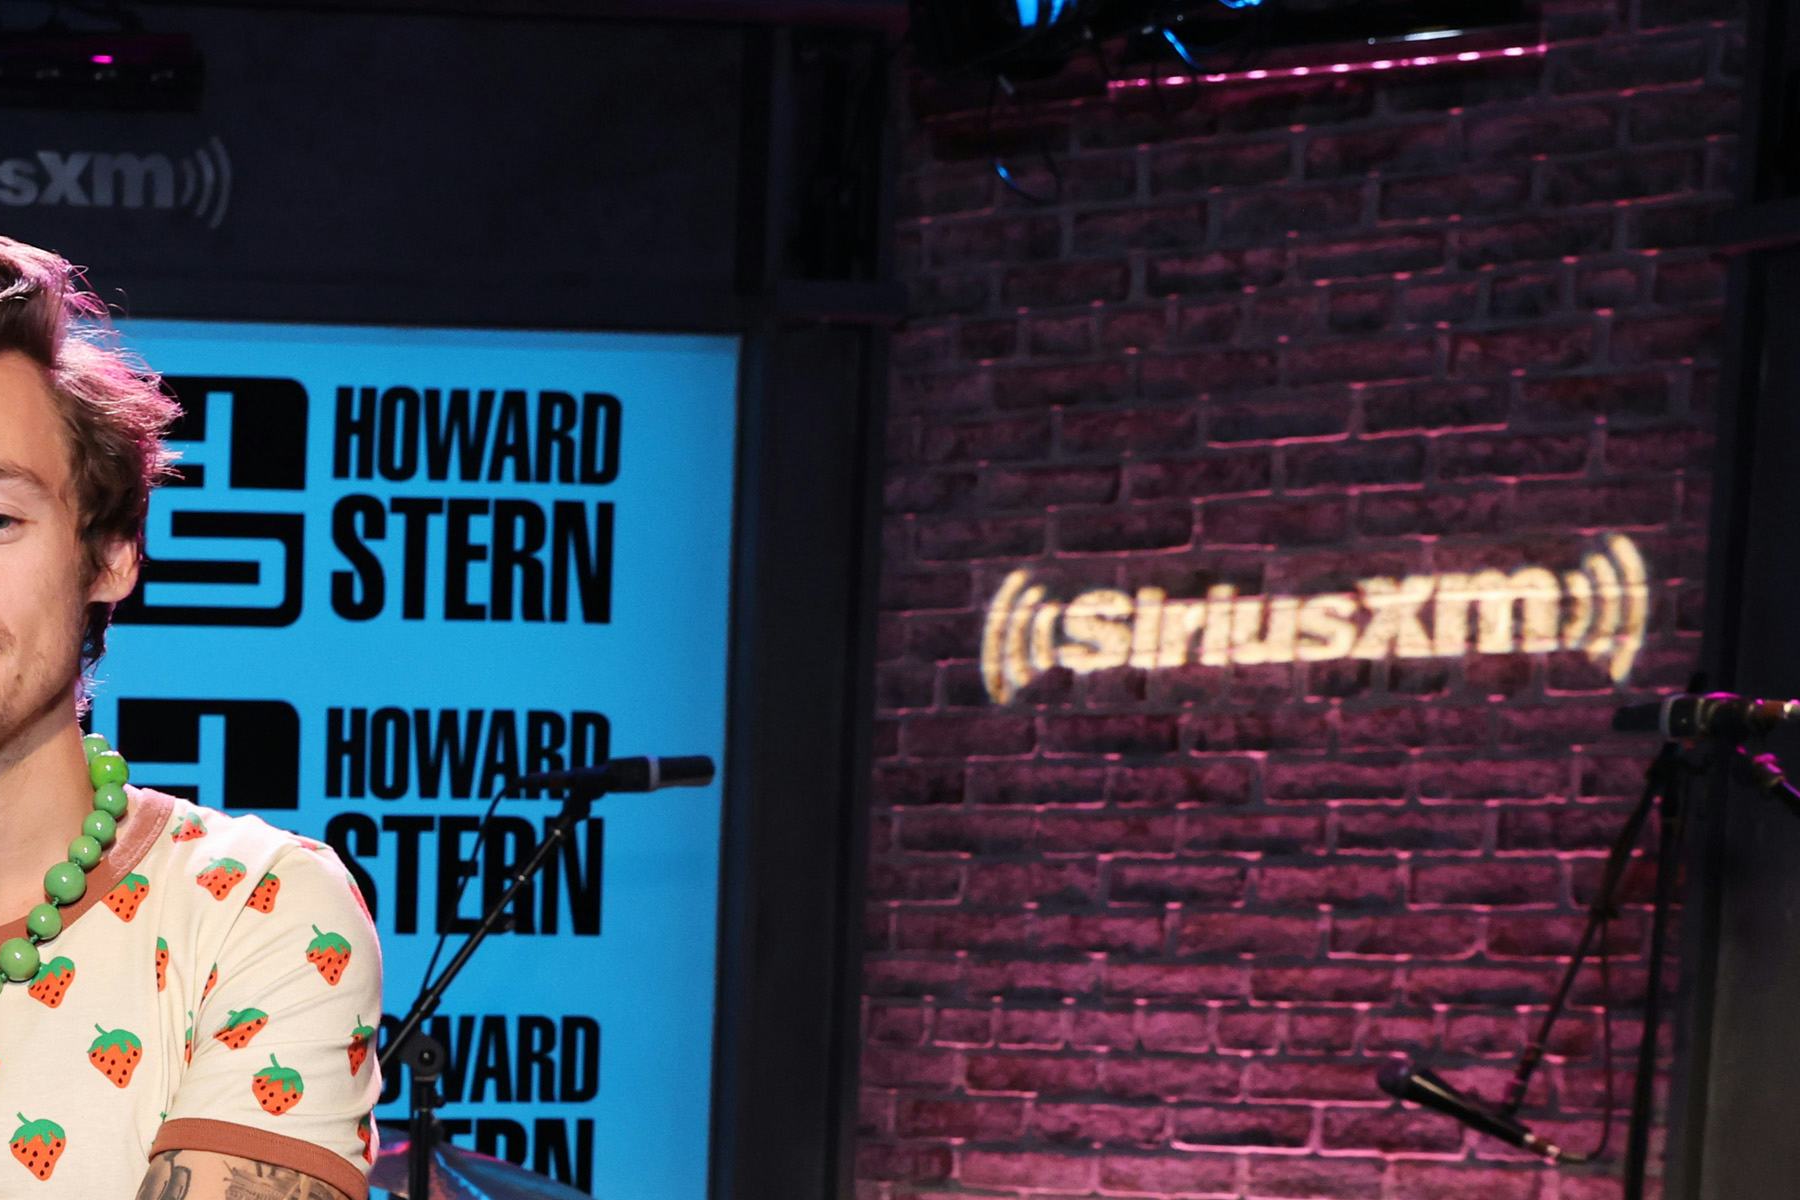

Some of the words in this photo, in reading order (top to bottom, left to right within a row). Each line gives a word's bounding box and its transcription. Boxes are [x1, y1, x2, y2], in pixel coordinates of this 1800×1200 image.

[331, 385, 623, 486] HOWARD
[330, 494, 615, 624] STERN
[325, 707, 610, 800] HOWARD
[325, 812, 604, 936] STERN
[378, 1013, 600, 1105] WARD
